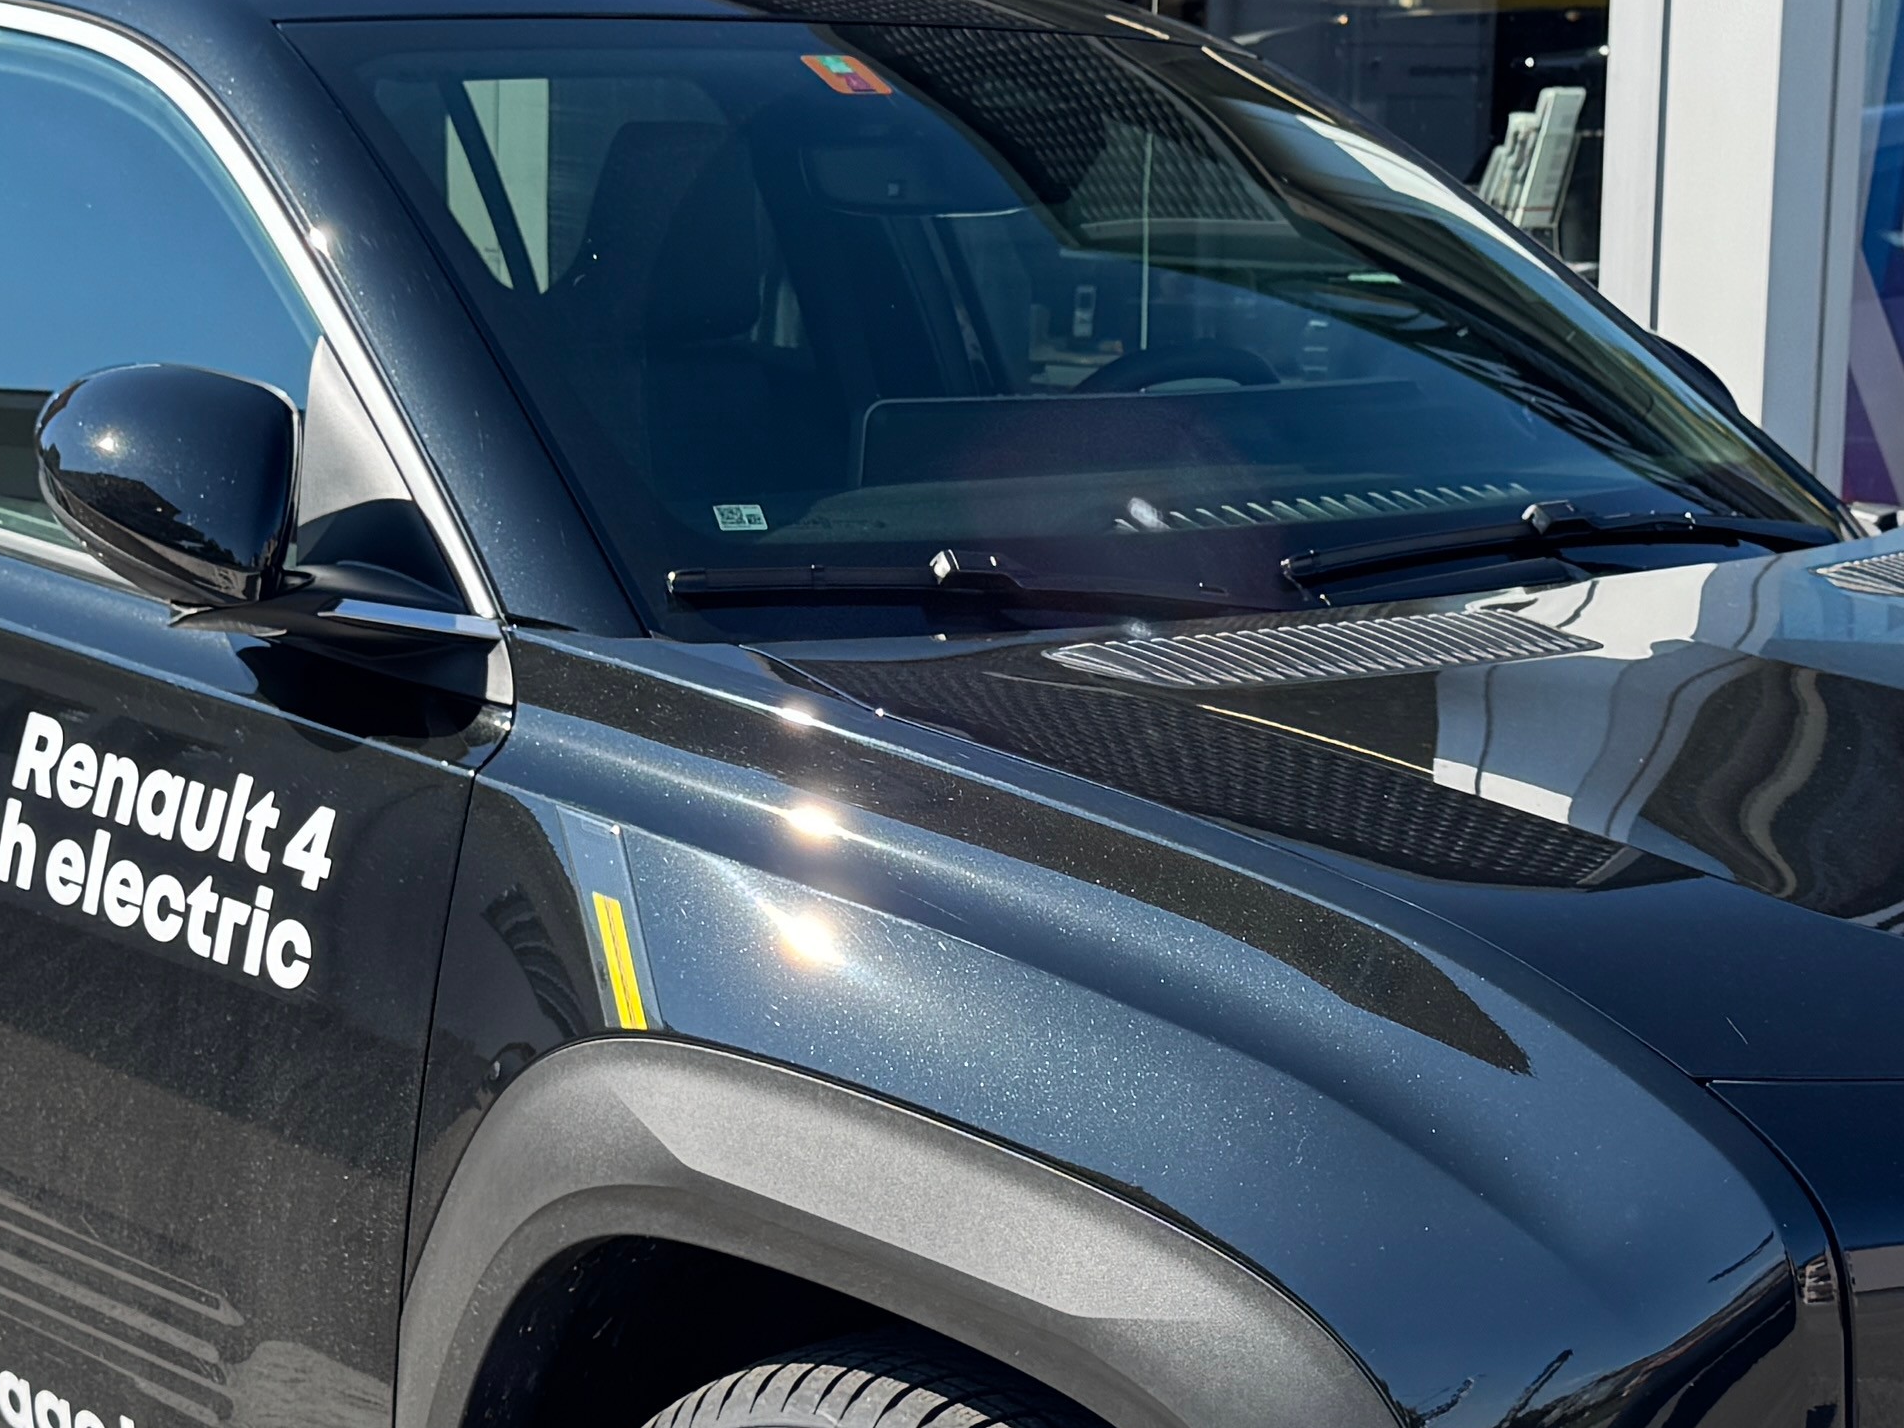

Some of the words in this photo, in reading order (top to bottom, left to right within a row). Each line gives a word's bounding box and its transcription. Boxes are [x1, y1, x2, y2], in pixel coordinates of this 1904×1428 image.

[12, 711, 279, 873] Renault
[282, 806, 336, 890] 4
[46, 829, 312, 989] electric
